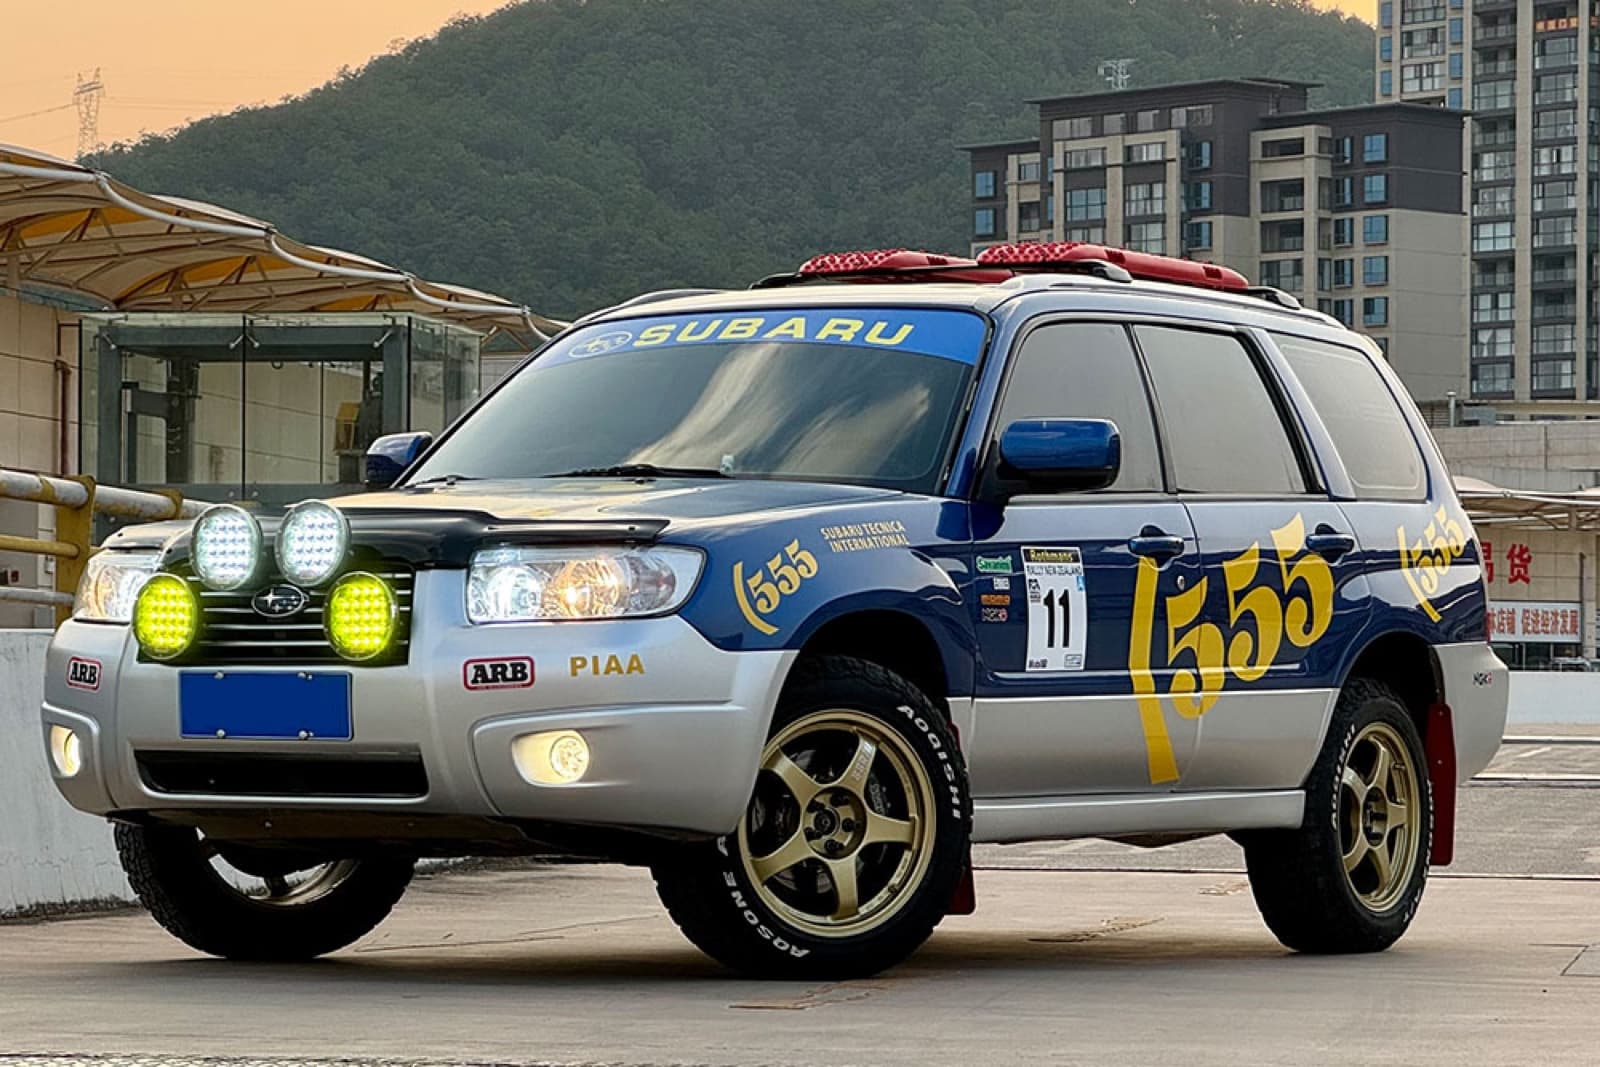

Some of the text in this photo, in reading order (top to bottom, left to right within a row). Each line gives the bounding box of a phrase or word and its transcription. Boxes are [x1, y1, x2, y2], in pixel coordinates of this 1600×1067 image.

[632, 317, 914, 347] SUBARU
[820, 520, 906, 540] SUBARU TECNICA
[828, 534, 909, 552] INTERNATIONAL
[747, 539, 818, 614] 555
[1043, 589, 1070, 648] 11
[1166, 512, 1335, 719] 555
[70, 662, 97, 684] ARB
[470, 662, 528, 684] ARB
[570, 654, 645, 677] PIAA
